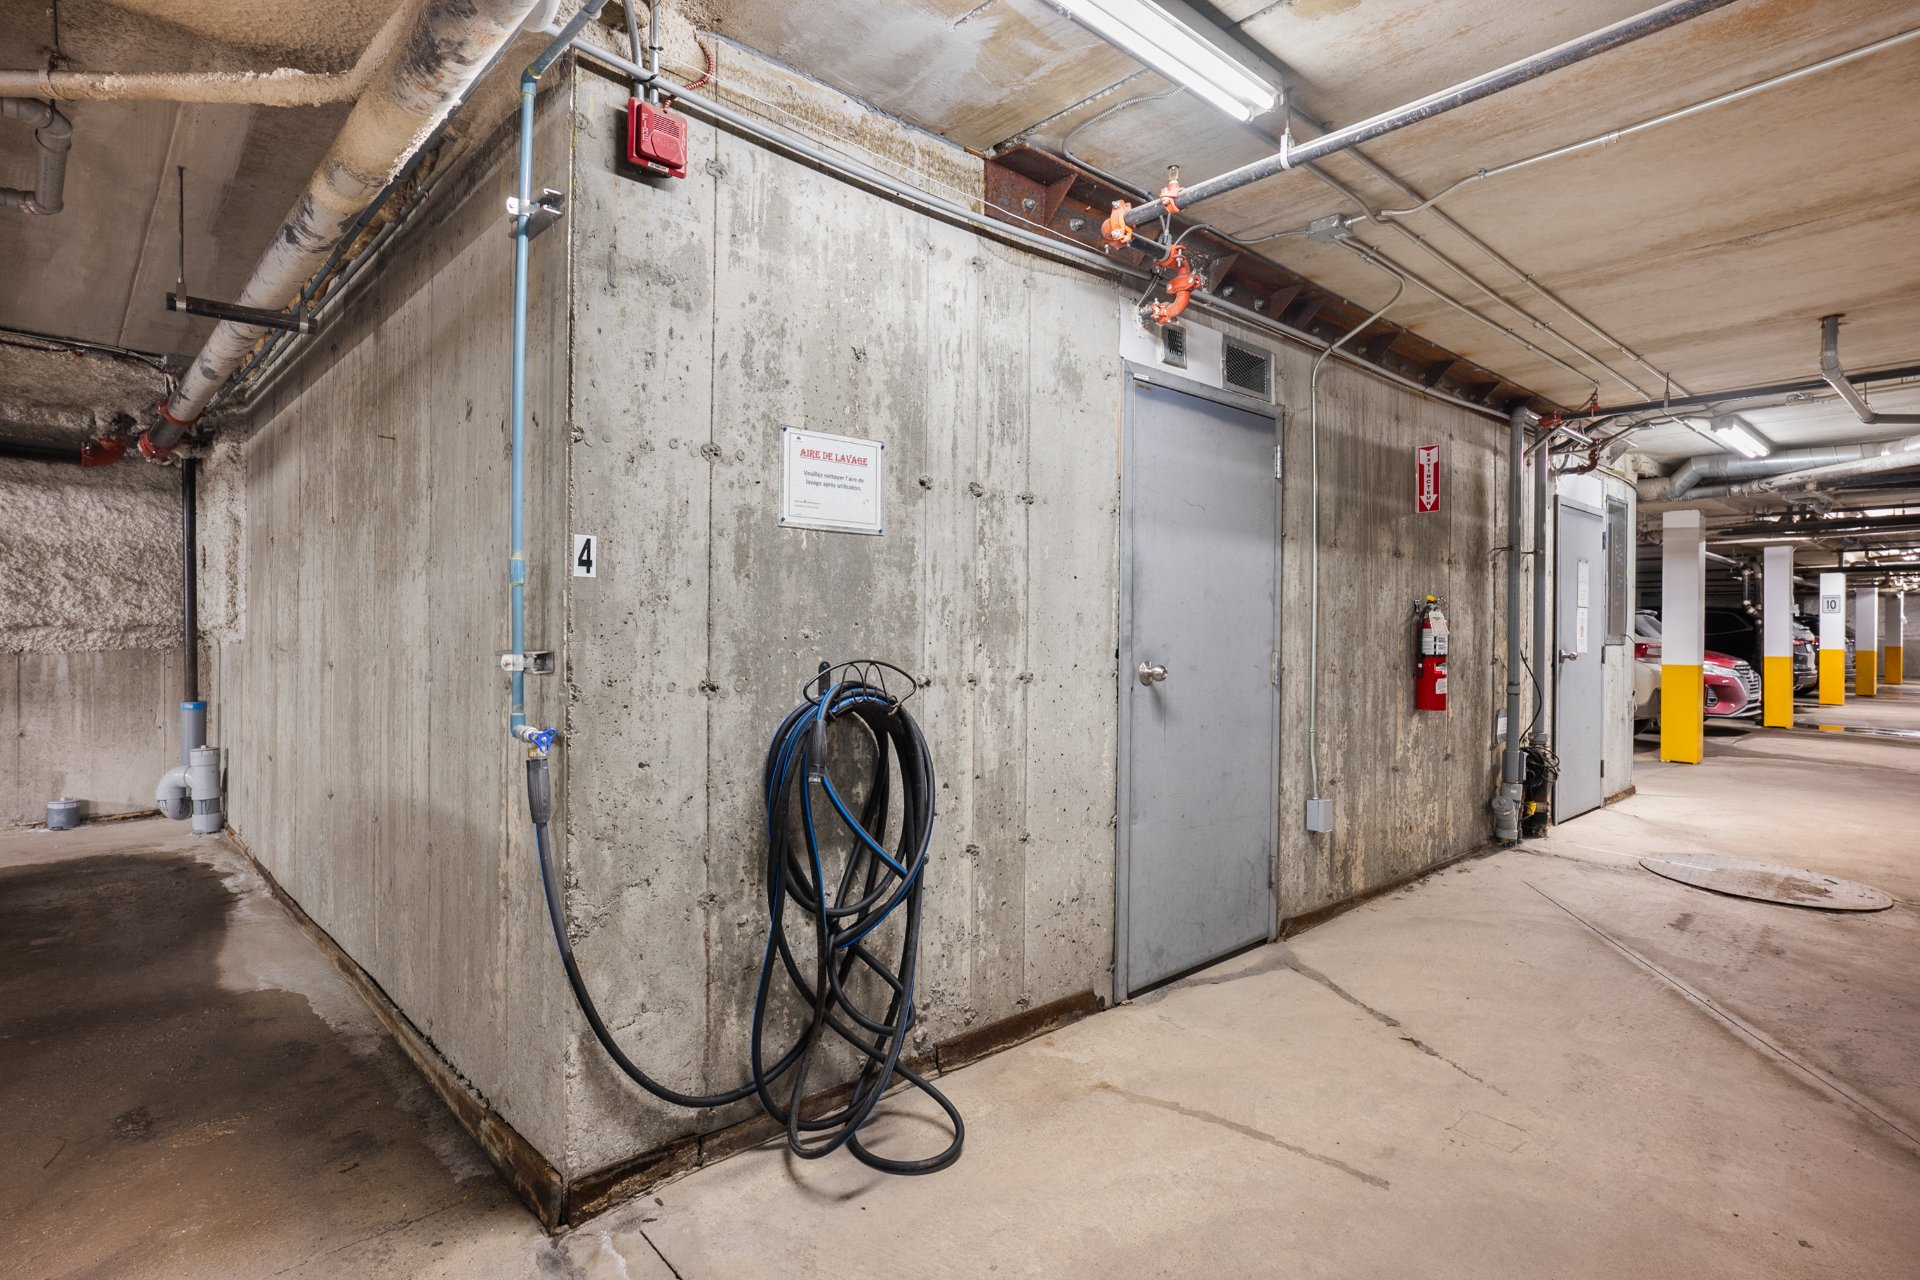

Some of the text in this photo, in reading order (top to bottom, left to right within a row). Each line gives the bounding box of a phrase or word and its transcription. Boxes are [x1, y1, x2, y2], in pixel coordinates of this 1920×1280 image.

[800, 448, 868, 466] AIRE DE LAVAGE
[824, 473, 844, 481] nettoyer
[805, 479, 822, 487] lavage
[578, 538, 592, 573] 4
[1826, 600, 1836, 609] 10
